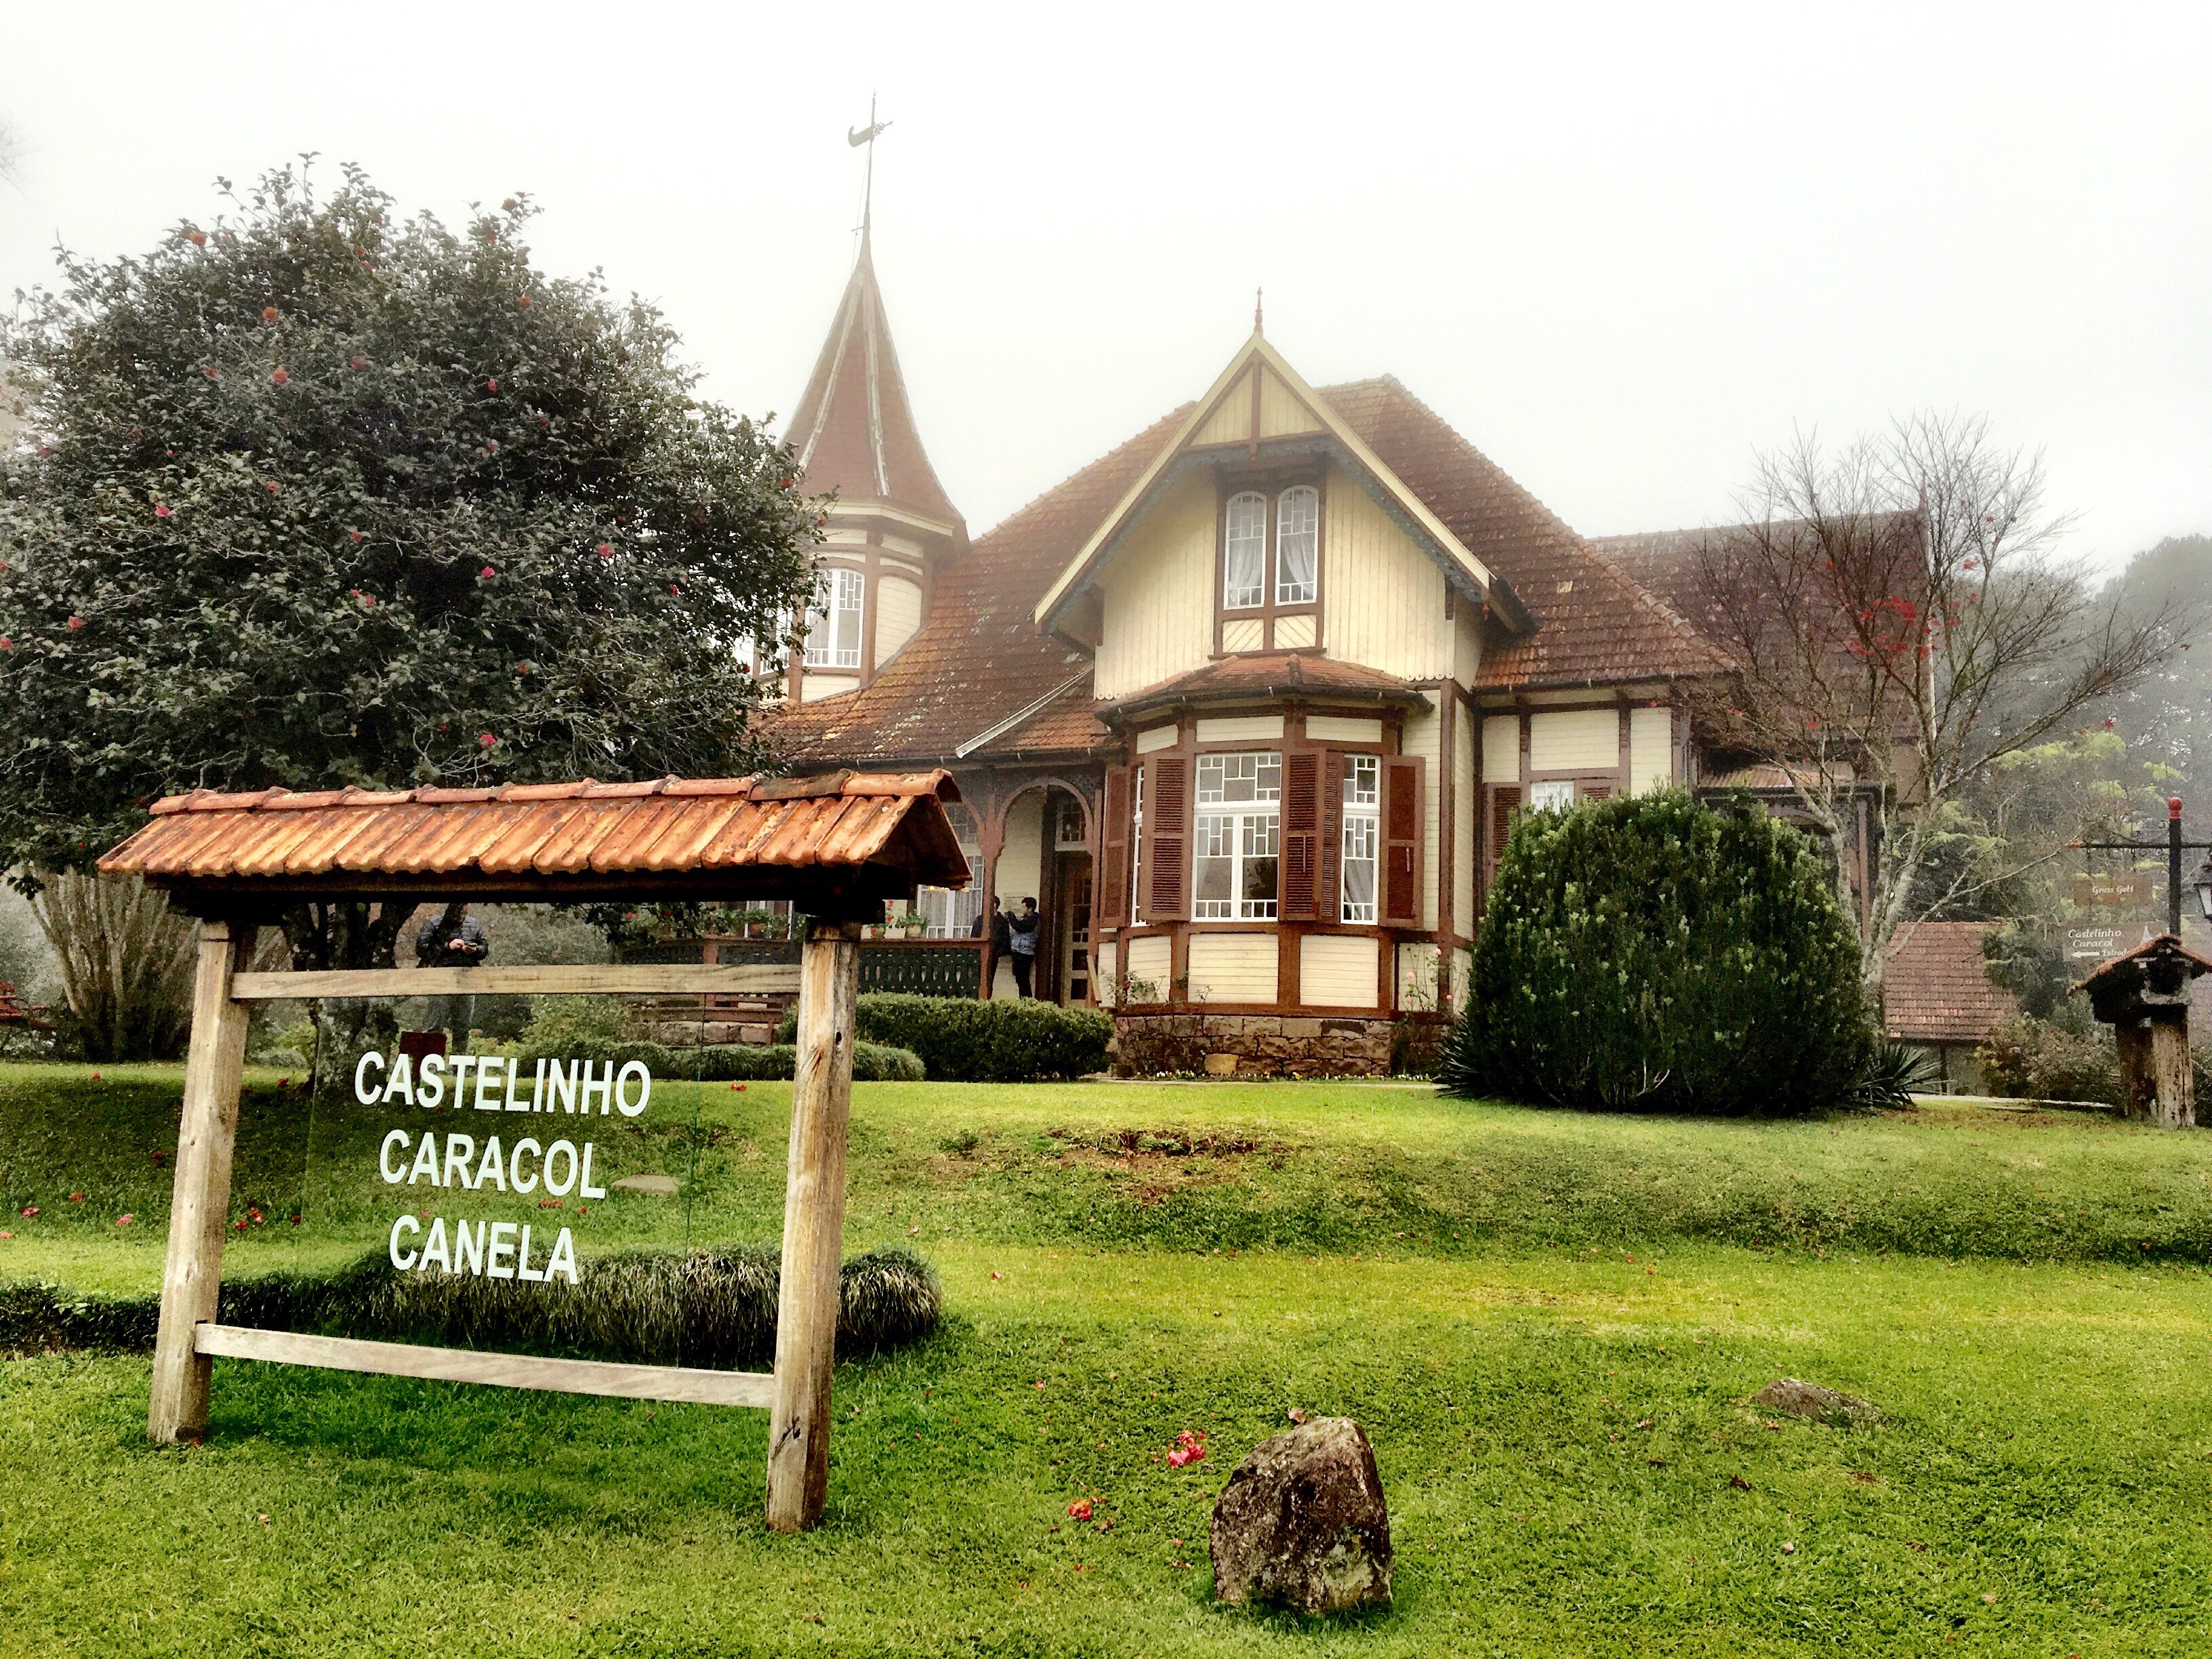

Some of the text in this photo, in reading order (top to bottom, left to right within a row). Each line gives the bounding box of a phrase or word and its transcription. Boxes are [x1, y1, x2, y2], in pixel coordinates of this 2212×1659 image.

[2068, 928, 2122, 938] Castelinho
[2072, 939, 2112, 947] Caracol
[354, 1051, 651, 1117] CASTELINHO
[380, 1129, 607, 1199] CARACOL
[390, 1214, 579, 1285] CANELA
